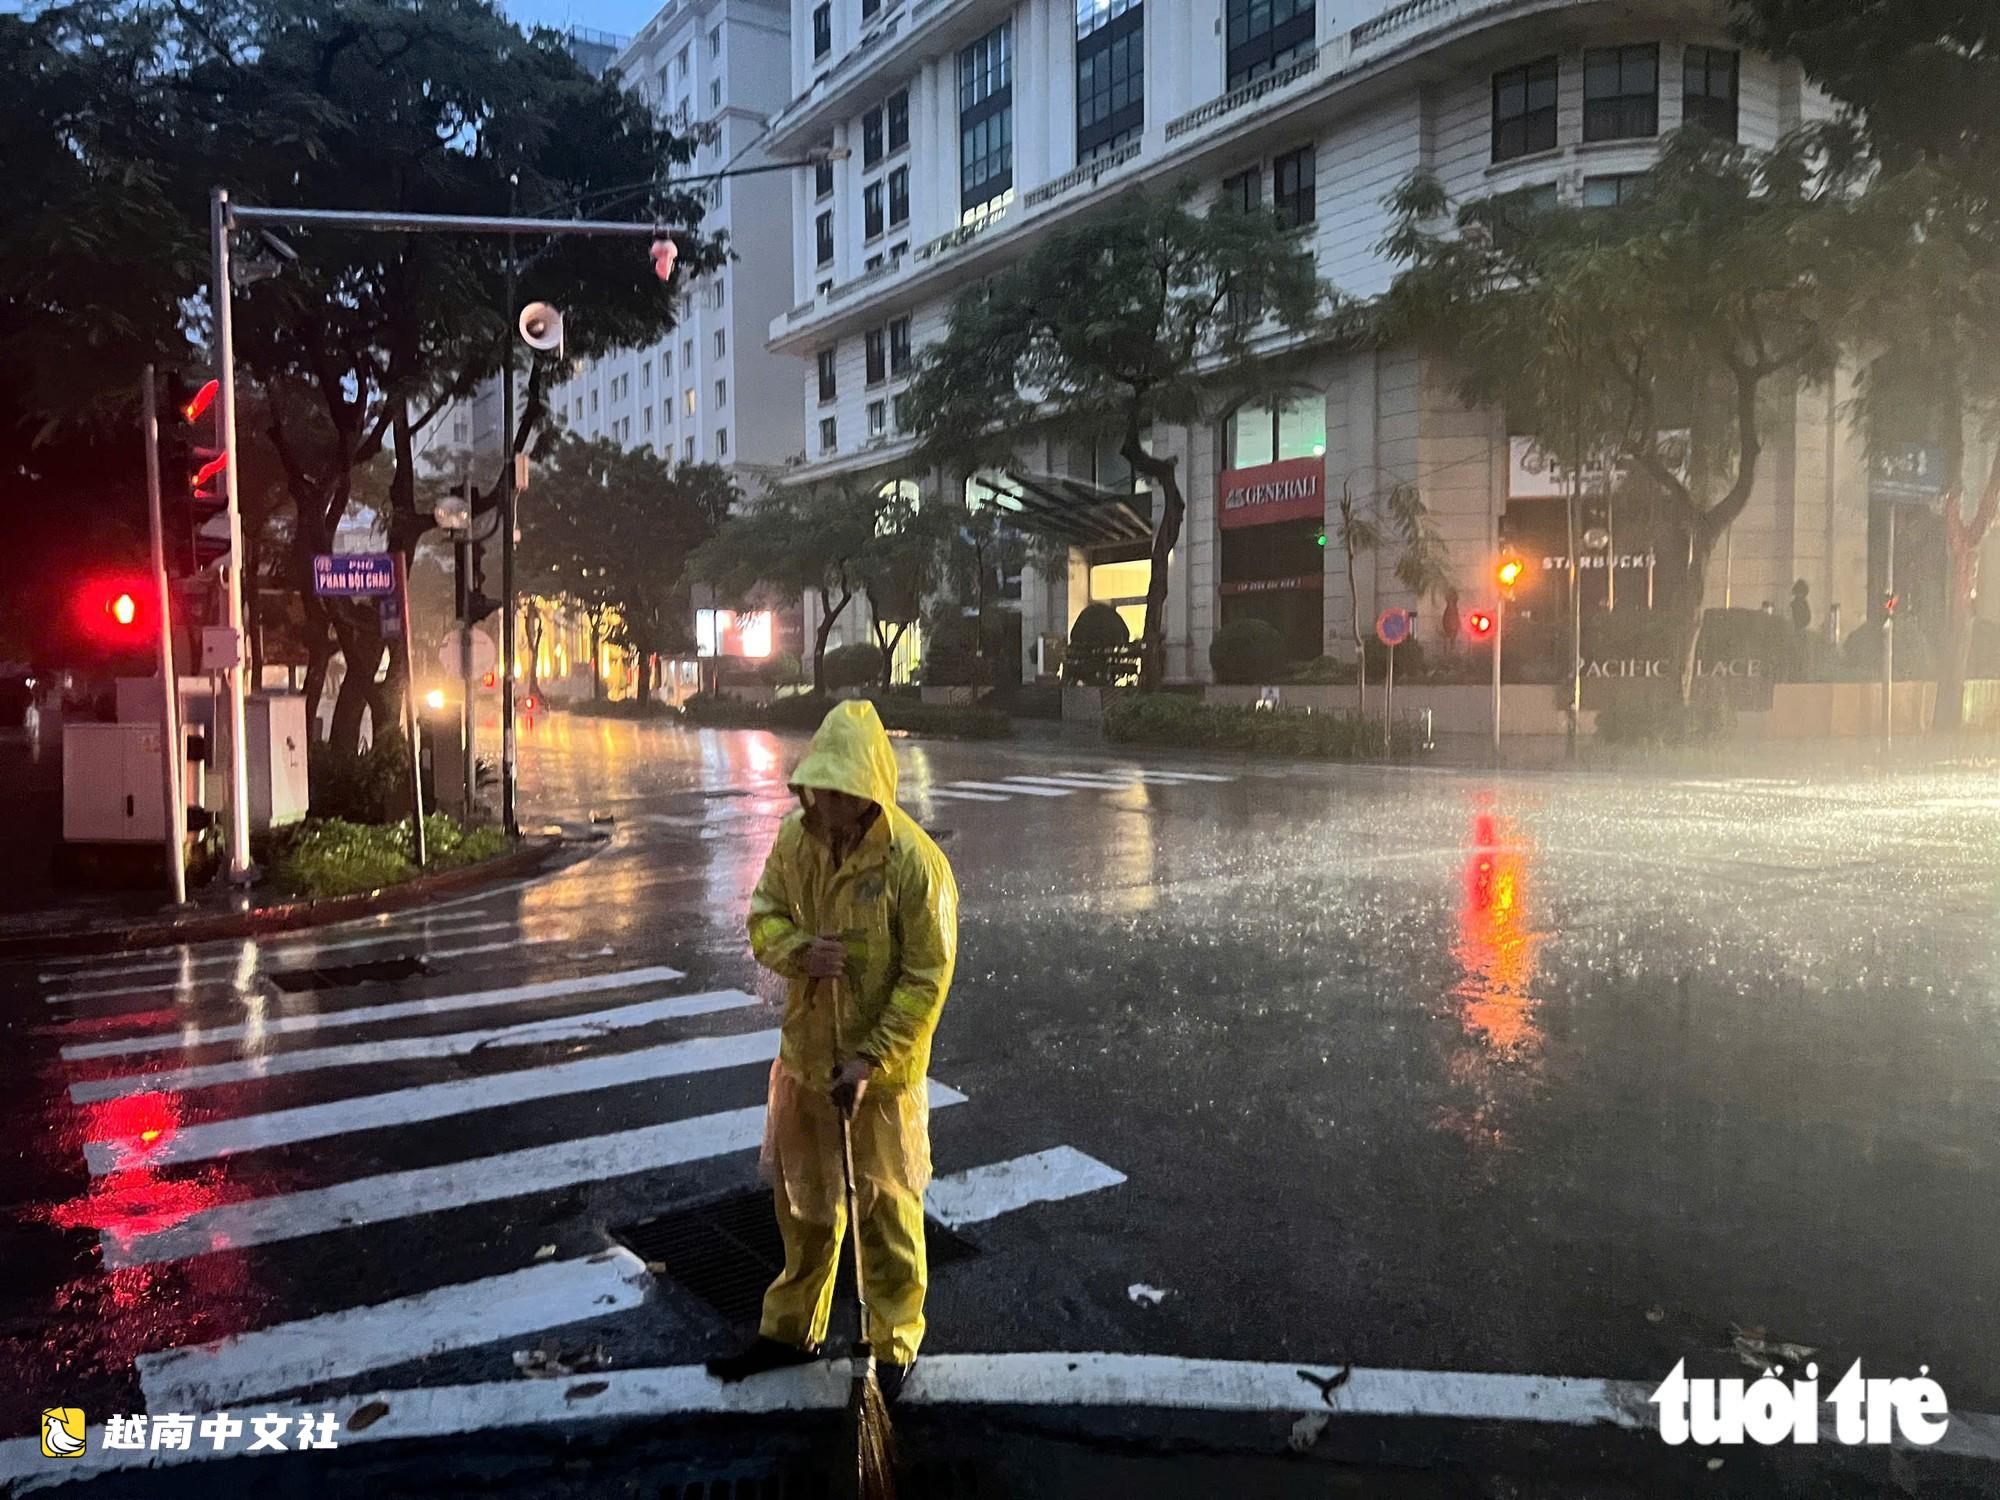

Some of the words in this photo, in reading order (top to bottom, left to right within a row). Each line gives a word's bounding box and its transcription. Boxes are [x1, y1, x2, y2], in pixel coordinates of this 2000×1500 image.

[1246, 475, 1317, 505] GENERALI
[320, 572, 346, 589] PHAN
[348, 570, 364, 592] BỘI
[366, 570, 390, 589] CHÂU
[1568, 657, 1668, 678] PACIFIC
[1683, 658, 1762, 678] LACE
